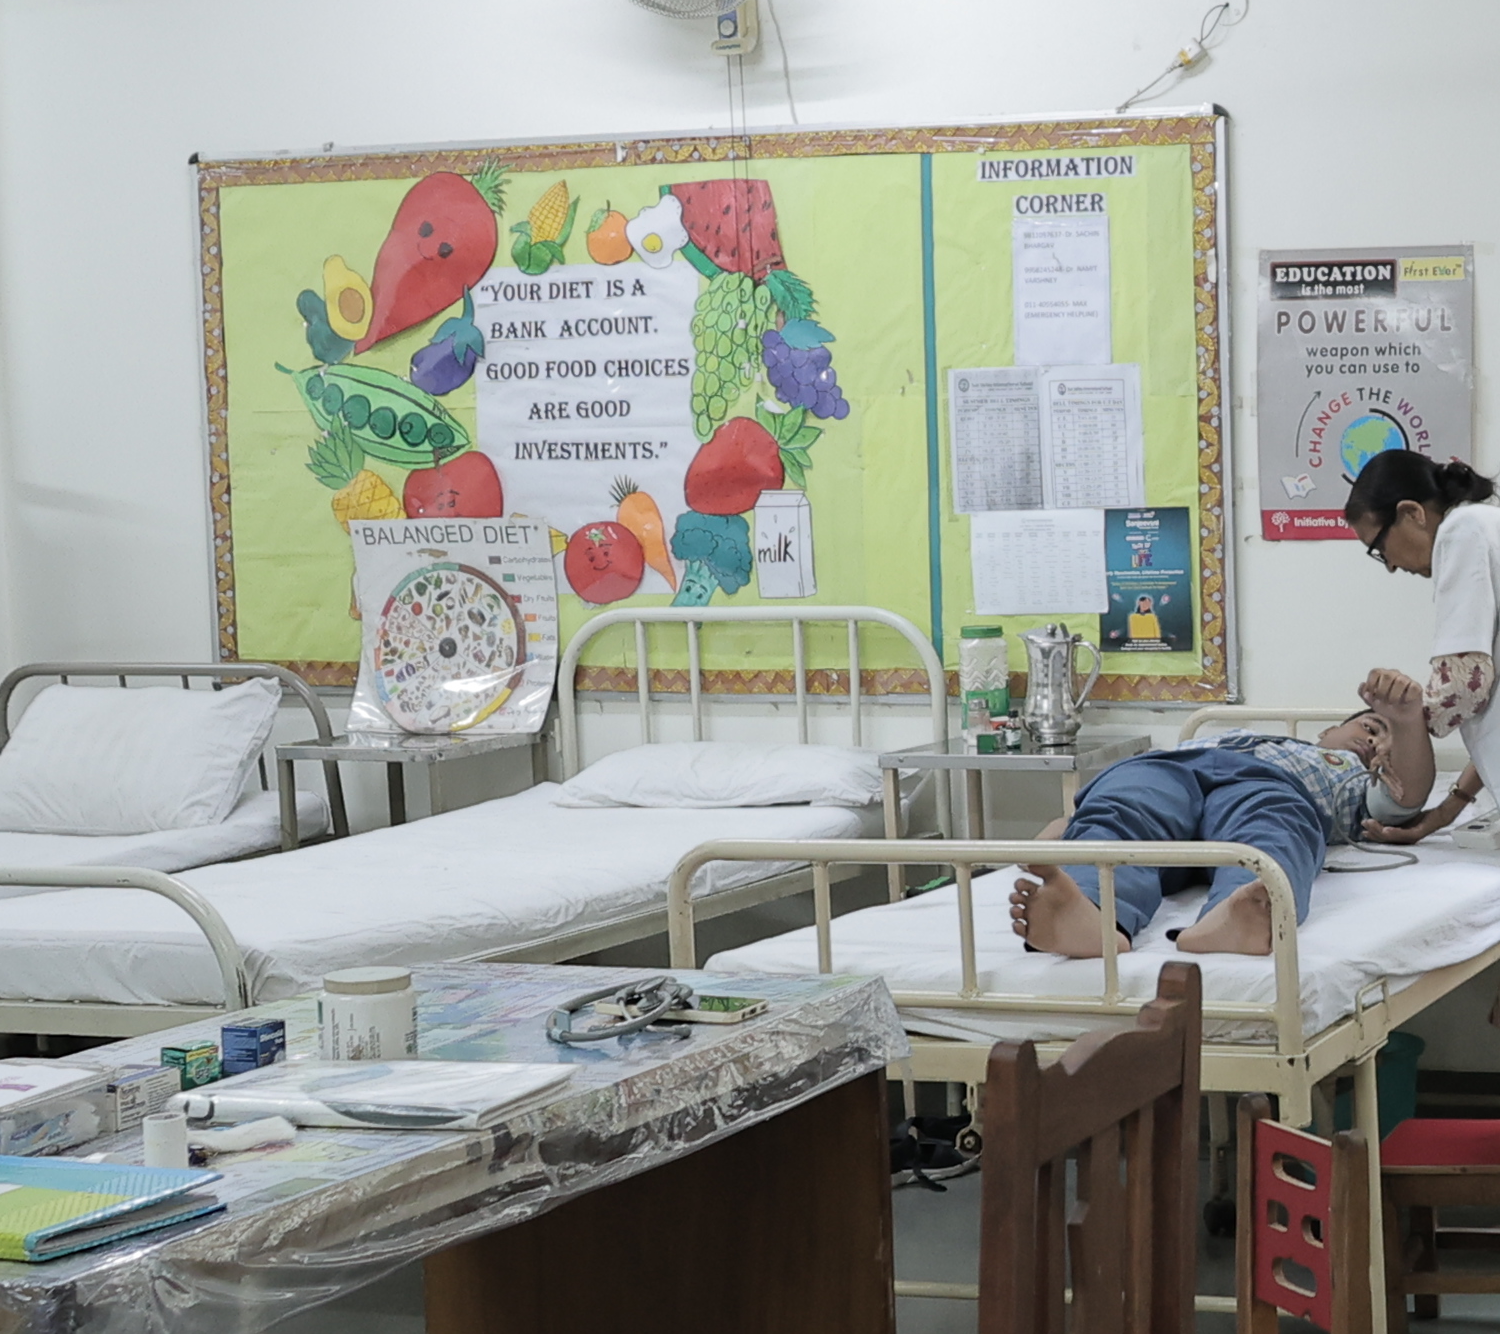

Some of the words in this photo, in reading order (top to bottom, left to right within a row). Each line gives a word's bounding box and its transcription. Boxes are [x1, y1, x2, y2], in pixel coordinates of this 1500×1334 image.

[980, 155, 1133, 180] INFORMATION
[1015, 193, 1104, 215] CORNER
[1275, 264, 1392, 283] EDUCATION
[548, 281, 594, 300] DIET
[605, 279, 625, 298] IS
[630, 278, 647, 296] A
[1313, 283, 1333, 296] the
[1335, 283, 1365, 295] most
[490, 320, 547, 340] BANK
[559, 316, 658, 337] ACCOUNT.
[1305, 345, 1369, 360] weapon
[1374, 342, 1421, 357] which
[486, 362, 540, 380] GOOD
[545, 359, 597, 379] FOOD
[604, 358, 690, 378] CHOICES
[1305, 362, 1334, 378] you
[1339, 362, 1367, 375] can
[1372, 362, 1400, 374] use
[1405, 361, 1421, 374] to
[528, 402, 571, 421] ARE
[576, 400, 631, 418] GOOD
[1308, 391, 1353, 468] CHANGE
[1356, 386, 1393, 405] THE
[1293, 516, 1336, 527] Initiative
[758, 532, 795, 563] milk
